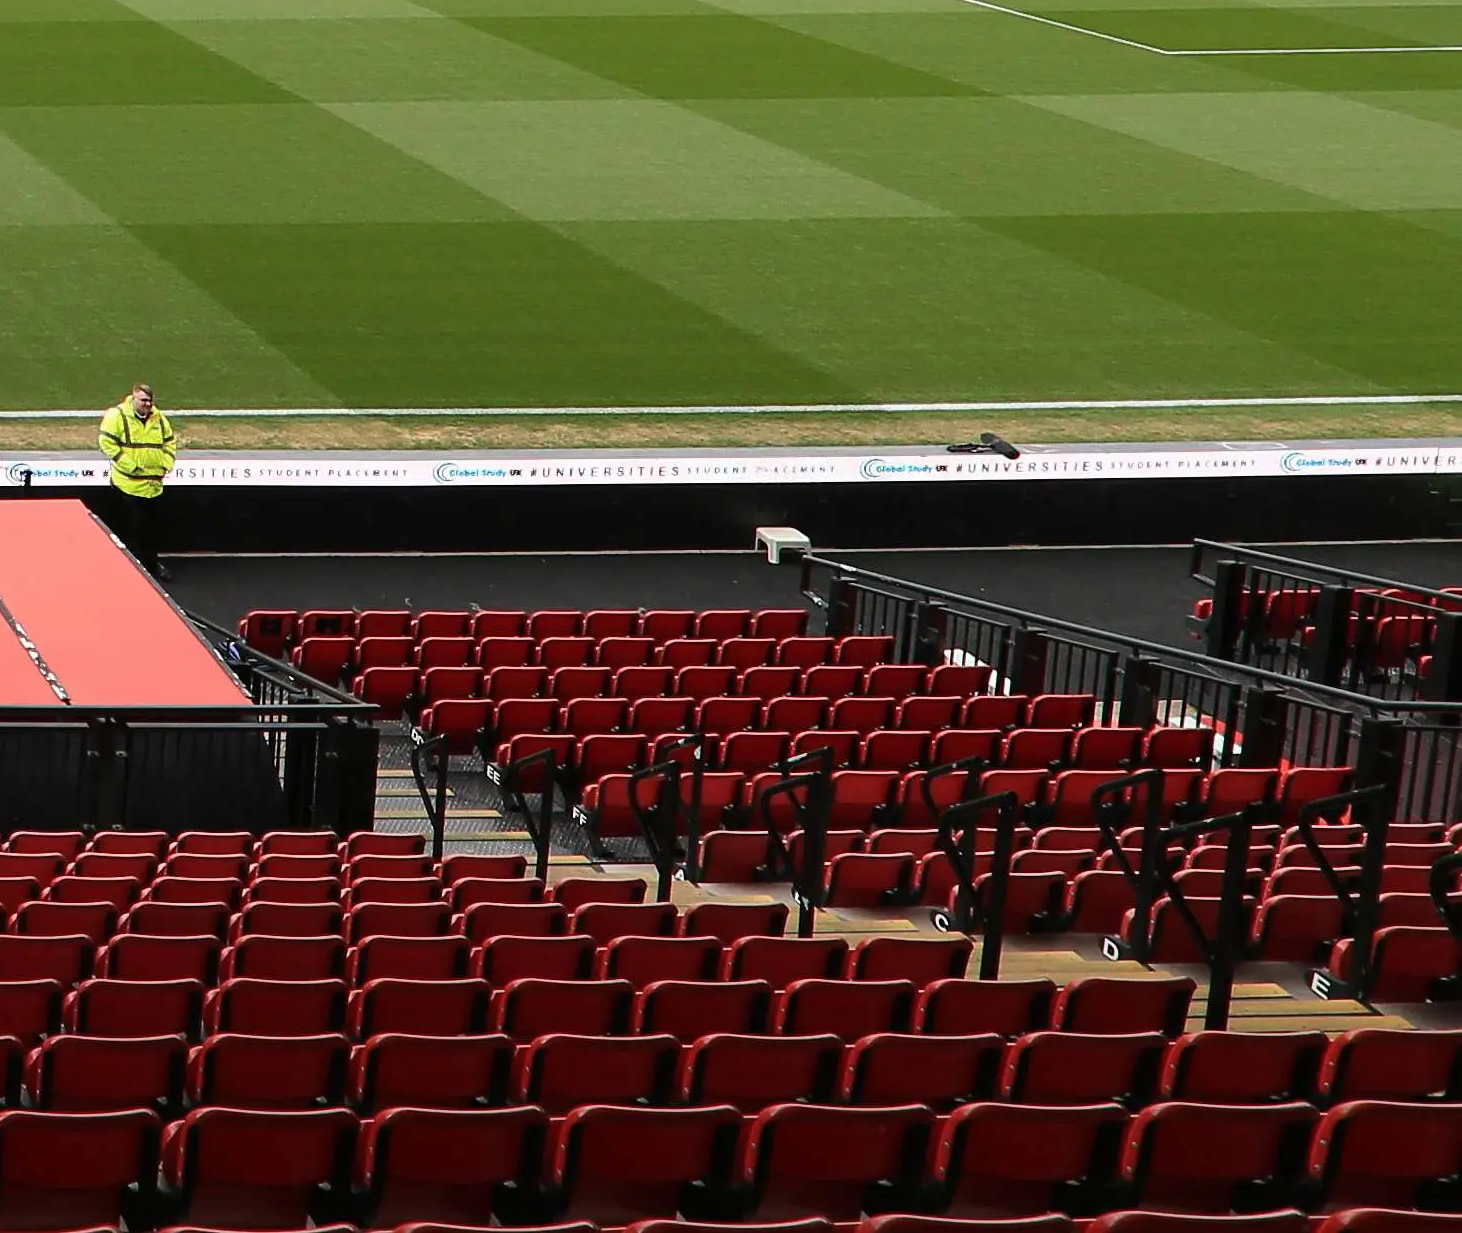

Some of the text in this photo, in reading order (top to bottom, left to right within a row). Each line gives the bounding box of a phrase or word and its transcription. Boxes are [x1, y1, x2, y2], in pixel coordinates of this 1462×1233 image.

[259, 469, 319, 477] STUDENT
[328, 469, 407, 477] PLACEMENT
[530, 467, 679, 478] #UNIVERSITIES
[687, 467, 748, 475] STUDENT
[956, 461, 1102, 473] #UNIVERSITIES
[1111, 462, 1169, 470] STUDENT
[1178, 460, 1256, 468] PLACEMENT
[486, 762, 501, 786] EE
[572, 806, 588, 825] FF
[934, 913, 949, 933] C
[1102, 937, 1119, 962] D
[1310, 972, 1332, 1001] E
